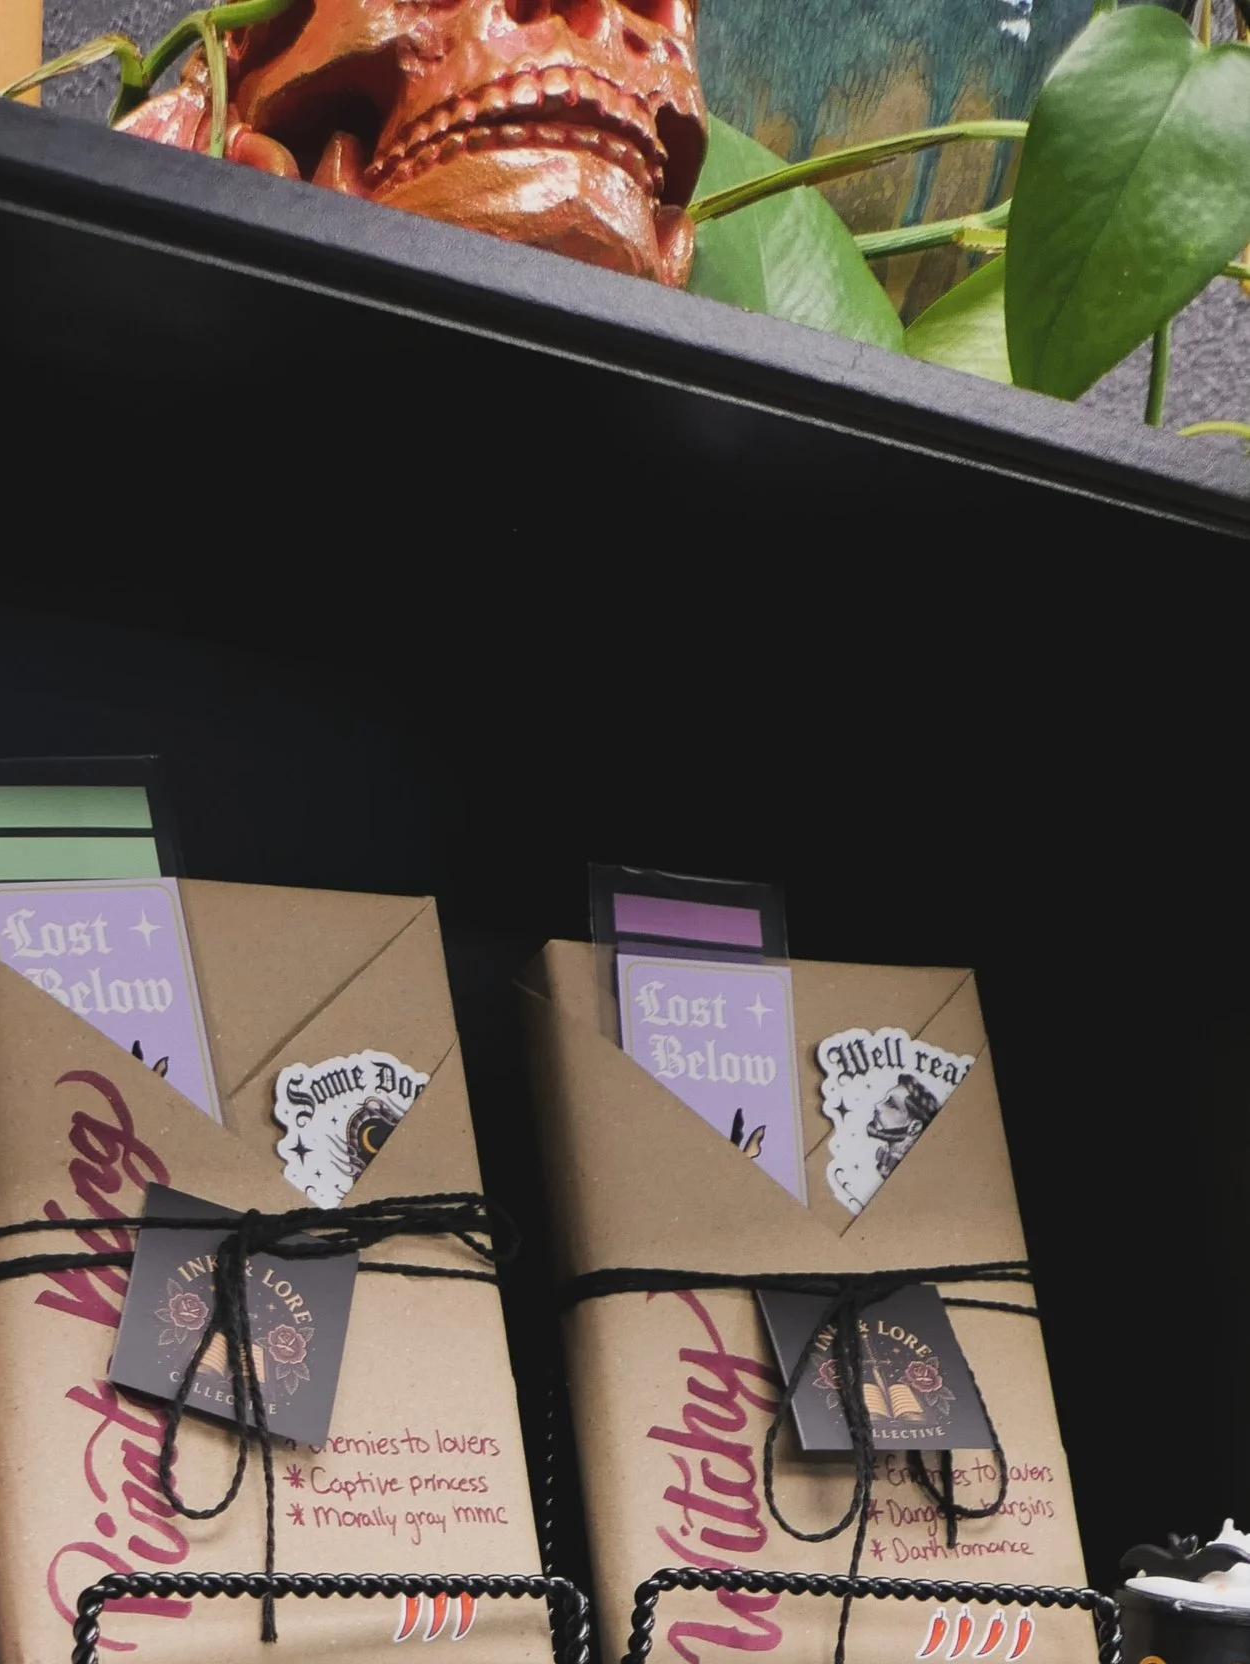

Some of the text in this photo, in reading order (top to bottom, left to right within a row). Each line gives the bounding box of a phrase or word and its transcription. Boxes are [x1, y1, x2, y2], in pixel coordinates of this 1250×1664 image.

[0, 908, 113, 960] Lost
[635, 981, 728, 1030] Lost
[649, 1033, 778, 1088] Below
[827, 1036, 970, 1087] Well rea
[285, 1062, 427, 1128] Some Doo
[261, 1268, 313, 1326] LORE
[877, 1320, 933, 1358] LORE
[309, 1428, 500, 1456] nemies to lovers
[872, 1426, 945, 1439] LLECTIVE
[310, 1466, 489, 1501] Captive princess
[972, 1457, 997, 1484] to
[1007, 1462, 1055, 1482] overs
[47, 1380, 191, 1650] Pirat
[405, 1510, 447, 1545] gray
[954, 1539, 1034, 1559] romance
